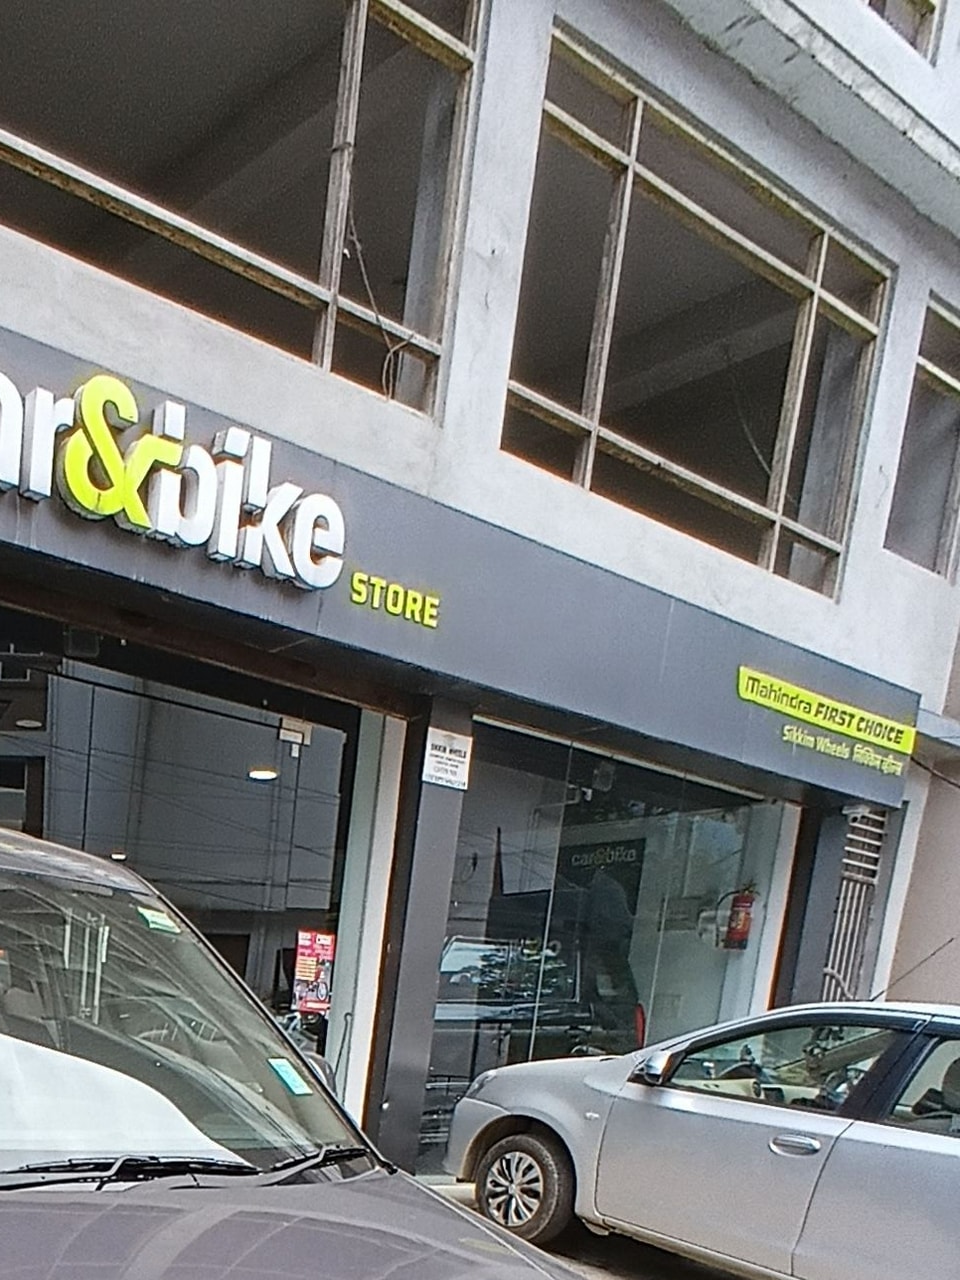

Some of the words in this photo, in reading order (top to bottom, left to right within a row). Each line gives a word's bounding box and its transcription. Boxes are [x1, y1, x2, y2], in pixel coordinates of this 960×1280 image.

[350, 571, 439, 629] STORE
[745, 675, 812, 714] Mahindra
[813, 701, 855, 728] FIRST
[856, 716, 905, 745] CHOICE
[782, 724, 815, 748] Sikkim
[816, 735, 851, 760] Wheels
